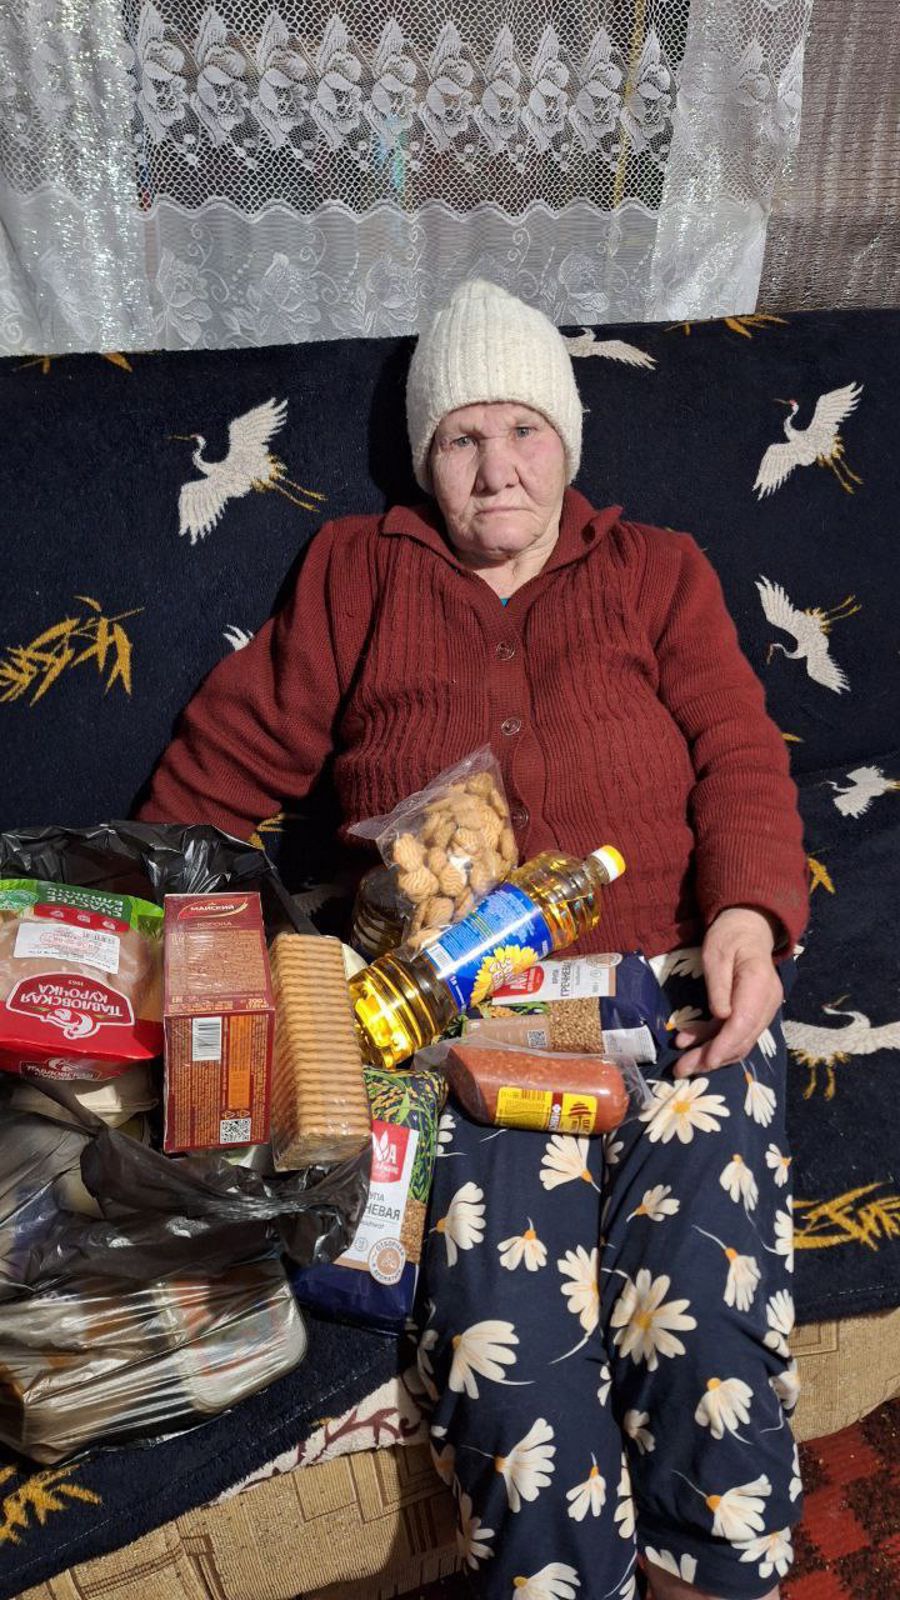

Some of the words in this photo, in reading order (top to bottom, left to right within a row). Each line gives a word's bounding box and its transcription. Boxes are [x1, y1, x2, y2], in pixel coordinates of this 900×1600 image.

[38, 983, 108, 1003] КУРОЧКА
[20, 991, 123, 1017] ПАВЛОВСКАЯ
[365, 1204, 401, 1221] НЕВАЯ
